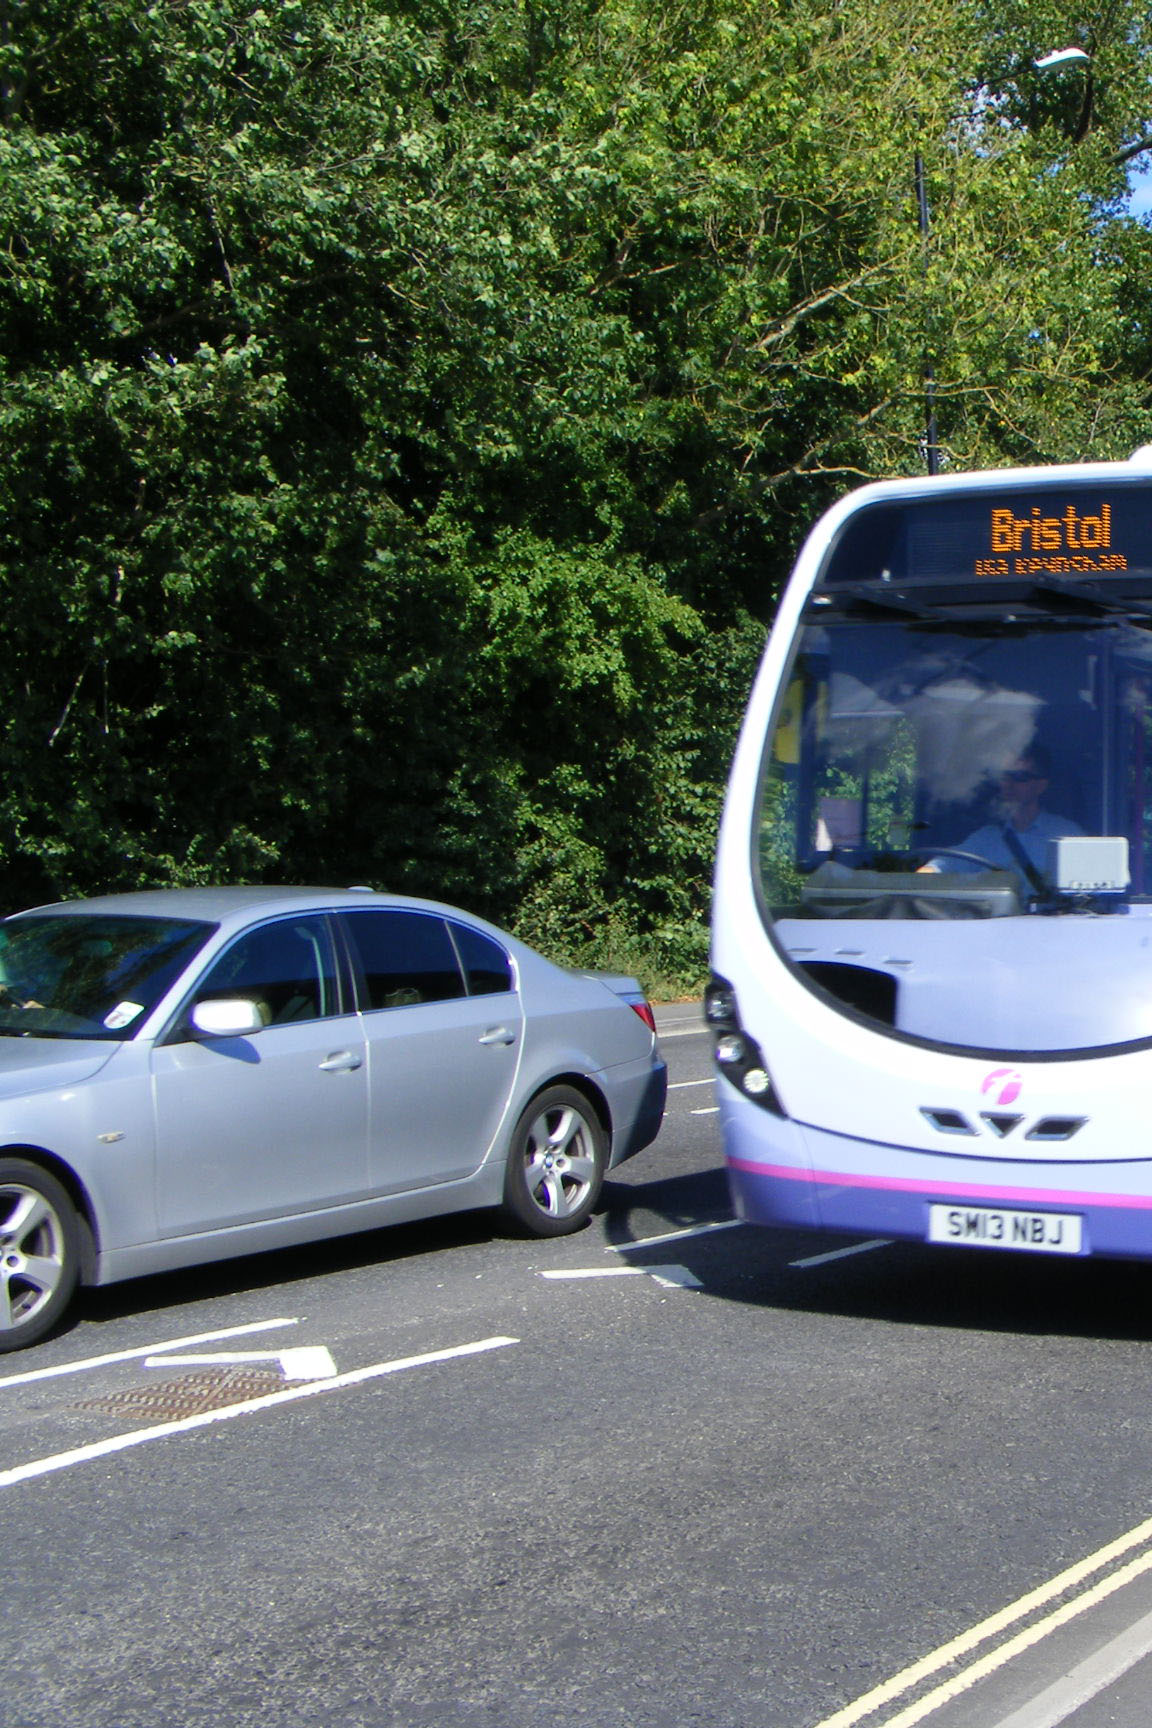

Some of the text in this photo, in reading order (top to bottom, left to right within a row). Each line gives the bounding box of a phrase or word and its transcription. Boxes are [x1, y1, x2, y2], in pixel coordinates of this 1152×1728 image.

[992, 503, 1112, 552] Bristol
[947, 1209, 1065, 1247] SM13 NBJ
